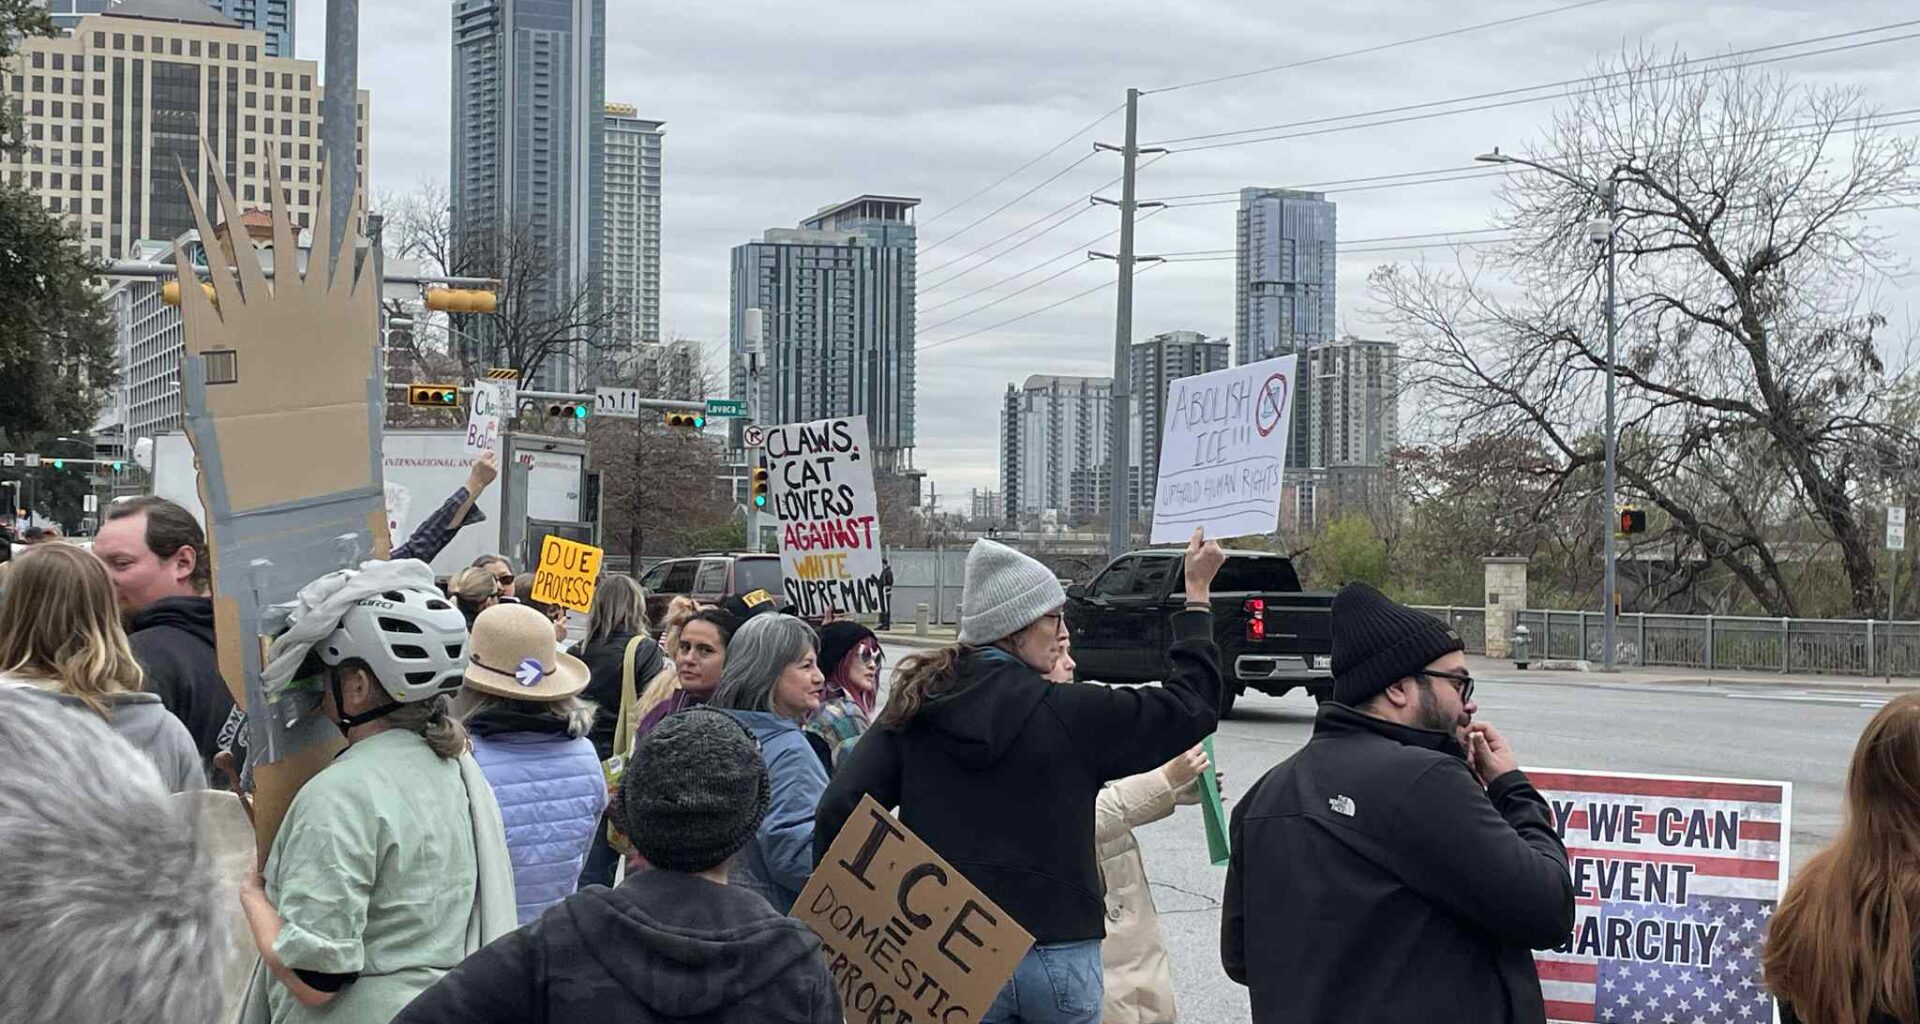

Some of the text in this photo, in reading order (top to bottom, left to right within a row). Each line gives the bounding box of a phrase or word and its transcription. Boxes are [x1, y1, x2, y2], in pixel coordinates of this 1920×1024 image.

[708, 403, 736, 414] Lavaca
[1171, 376, 1253, 433] ABOLISH
[784, 457, 834, 489] CAT
[1204, 466, 1237, 503] HUMAN
[1241, 463, 1280, 499] RIGHTS
[775, 484, 855, 521] LOVERS
[784, 516, 875, 551] AGAINST
[546, 541, 593, 573] DUE
[793, 552, 852, 579] WHITE
[534, 570, 592, 607] PROCESS
[784, 574, 887, 617] SUPREMACY
[1589, 803, 1643, 844] WE
[1657, 807, 1739, 851] CAN
[1573, 858, 1694, 905] EVENT
